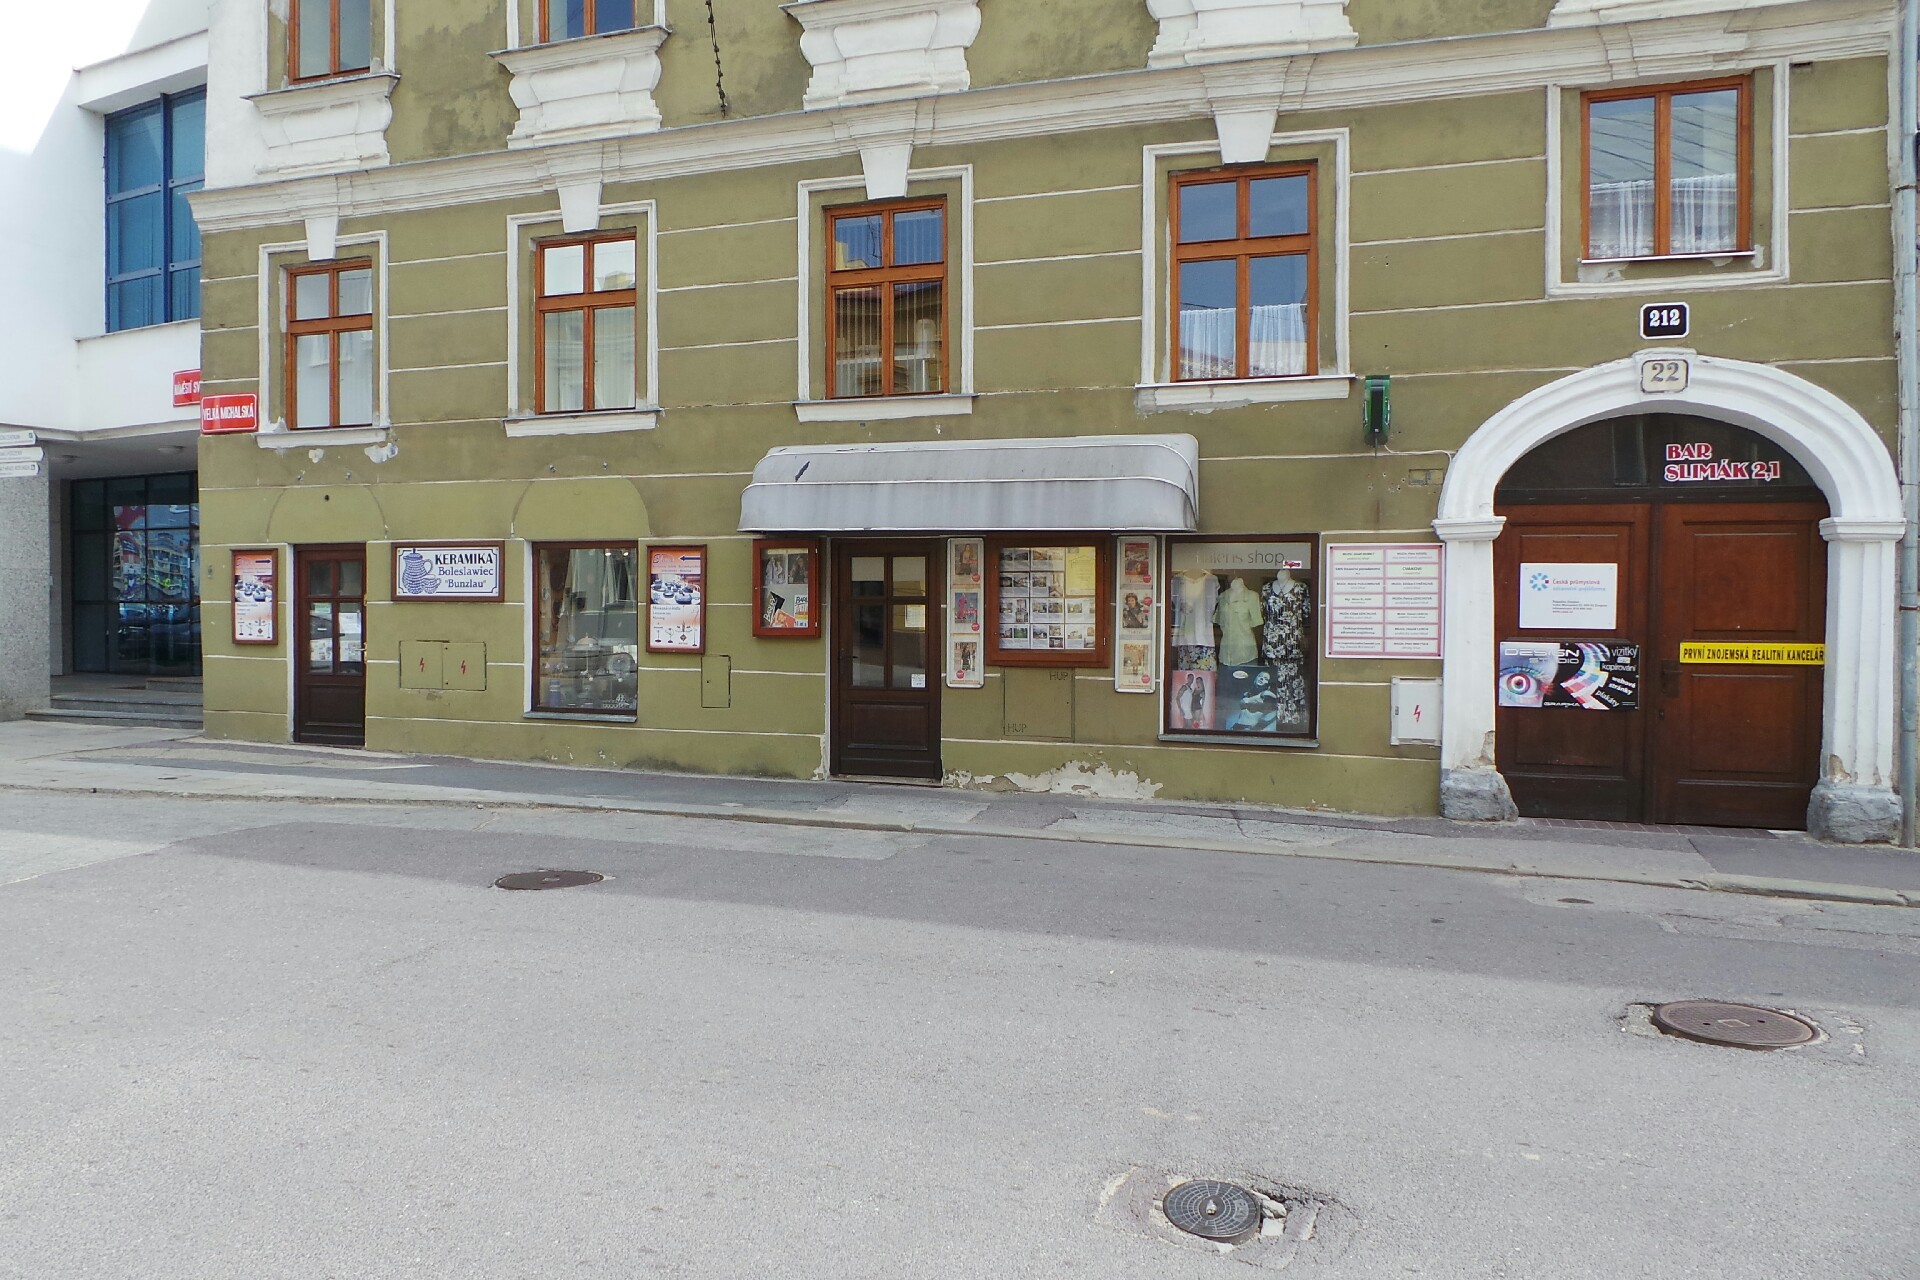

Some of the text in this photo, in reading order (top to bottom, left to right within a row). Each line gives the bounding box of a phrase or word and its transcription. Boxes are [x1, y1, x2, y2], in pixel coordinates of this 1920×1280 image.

[1649, 308, 1681, 327] 212
[1650, 362, 1679, 382] 22
[203, 403, 254, 420] VELKÁ MICHALSKÁ
[1666, 443, 1713, 460] BAR
[1664, 459, 1780, 481] SLIMÁK 2,1
[435, 554, 493, 565] KERAMIKA
[1247, 550, 1285, 566] shop
[438, 566, 494, 576] Boleslawiec
[1504, 648, 1580, 657] DESIGN
[1611, 646, 1638, 659] vizitky
[1683, 645, 1825, 661] PRVNÍ ZNOJEMSKÁ REALITNÍ KANCELÁŘ
[1049, 671, 1069, 681] HUP
